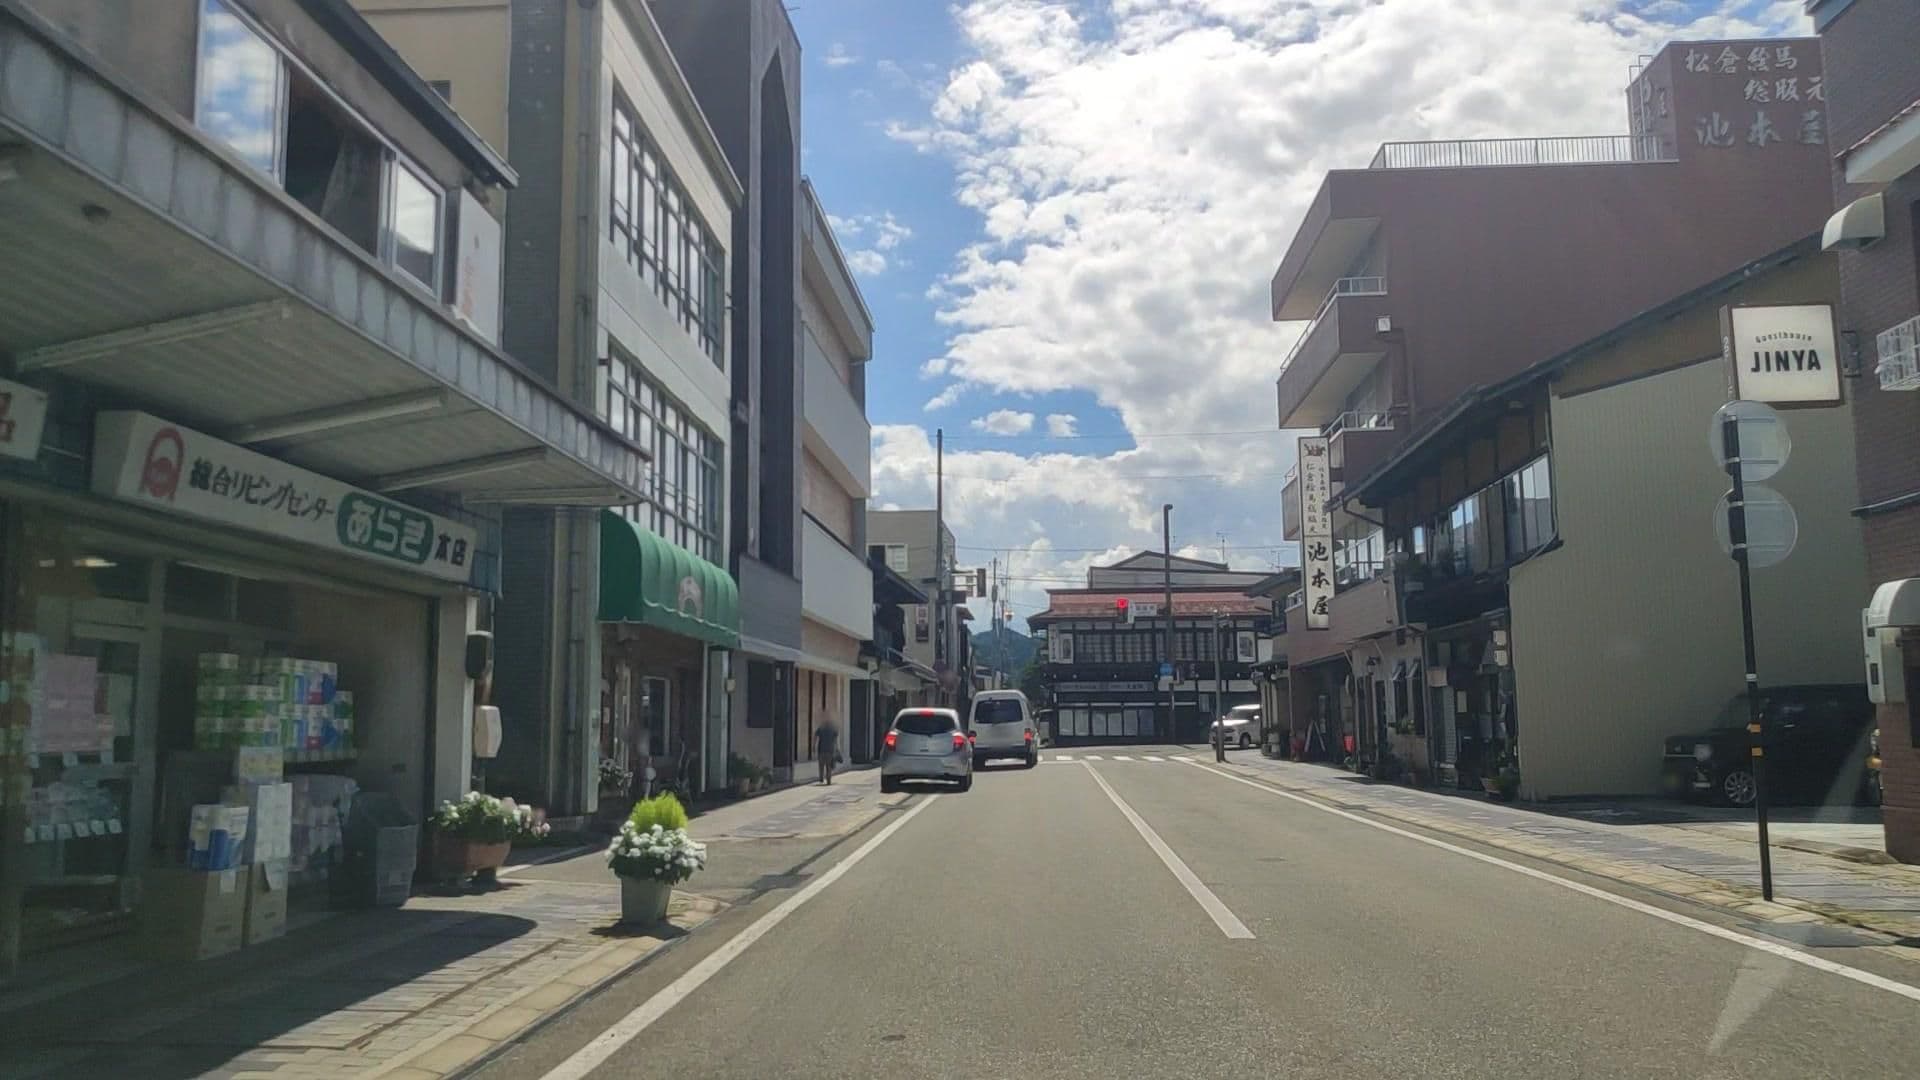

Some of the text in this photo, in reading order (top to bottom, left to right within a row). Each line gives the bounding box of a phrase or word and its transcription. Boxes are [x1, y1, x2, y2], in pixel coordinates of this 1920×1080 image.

[1685, 46, 1798, 73] 松倉絵馬
[1744, 76, 1825, 103] 総販元
[1750, 349, 1822, 373] JINYA
[347, 499, 426, 560] あらき
[434, 532, 468, 567] 本店
[1307, 541, 1331, 615] 池本屋
